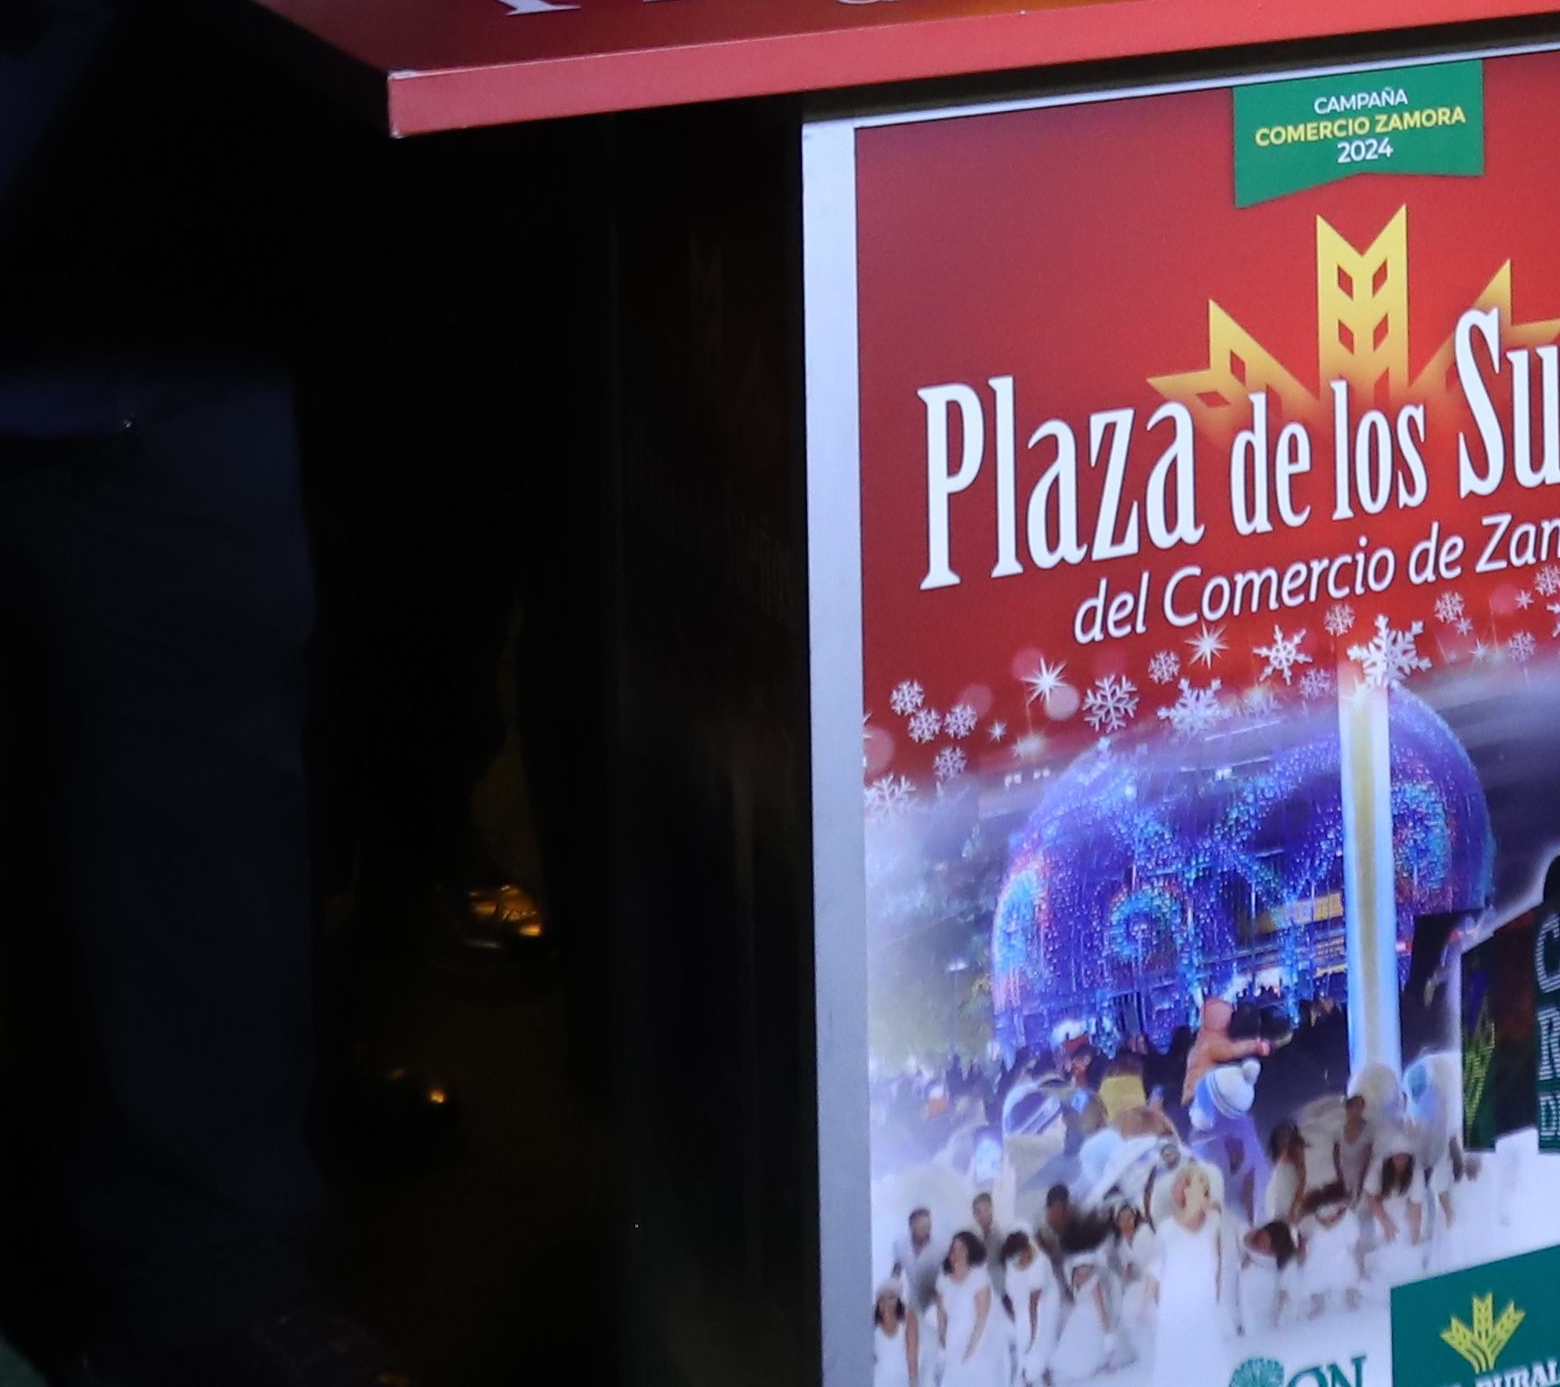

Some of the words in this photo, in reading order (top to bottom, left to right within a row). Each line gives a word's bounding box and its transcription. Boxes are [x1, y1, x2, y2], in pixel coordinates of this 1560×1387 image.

[1314, 87, 1408, 115] CAMPAÑA
[1255, 117, 1370, 146] COMERCIO
[1375, 106, 1466, 133] ZAMORA
[1337, 137, 1393, 163] 2024
[917, 375, 1204, 590] Plaza
[1230, 393, 1312, 535] de
[1330, 380, 1428, 520] los
[1073, 577, 1147, 645] del
[1163, 534, 1397, 628] Comercio
[1407, 520, 1464, 584] de
